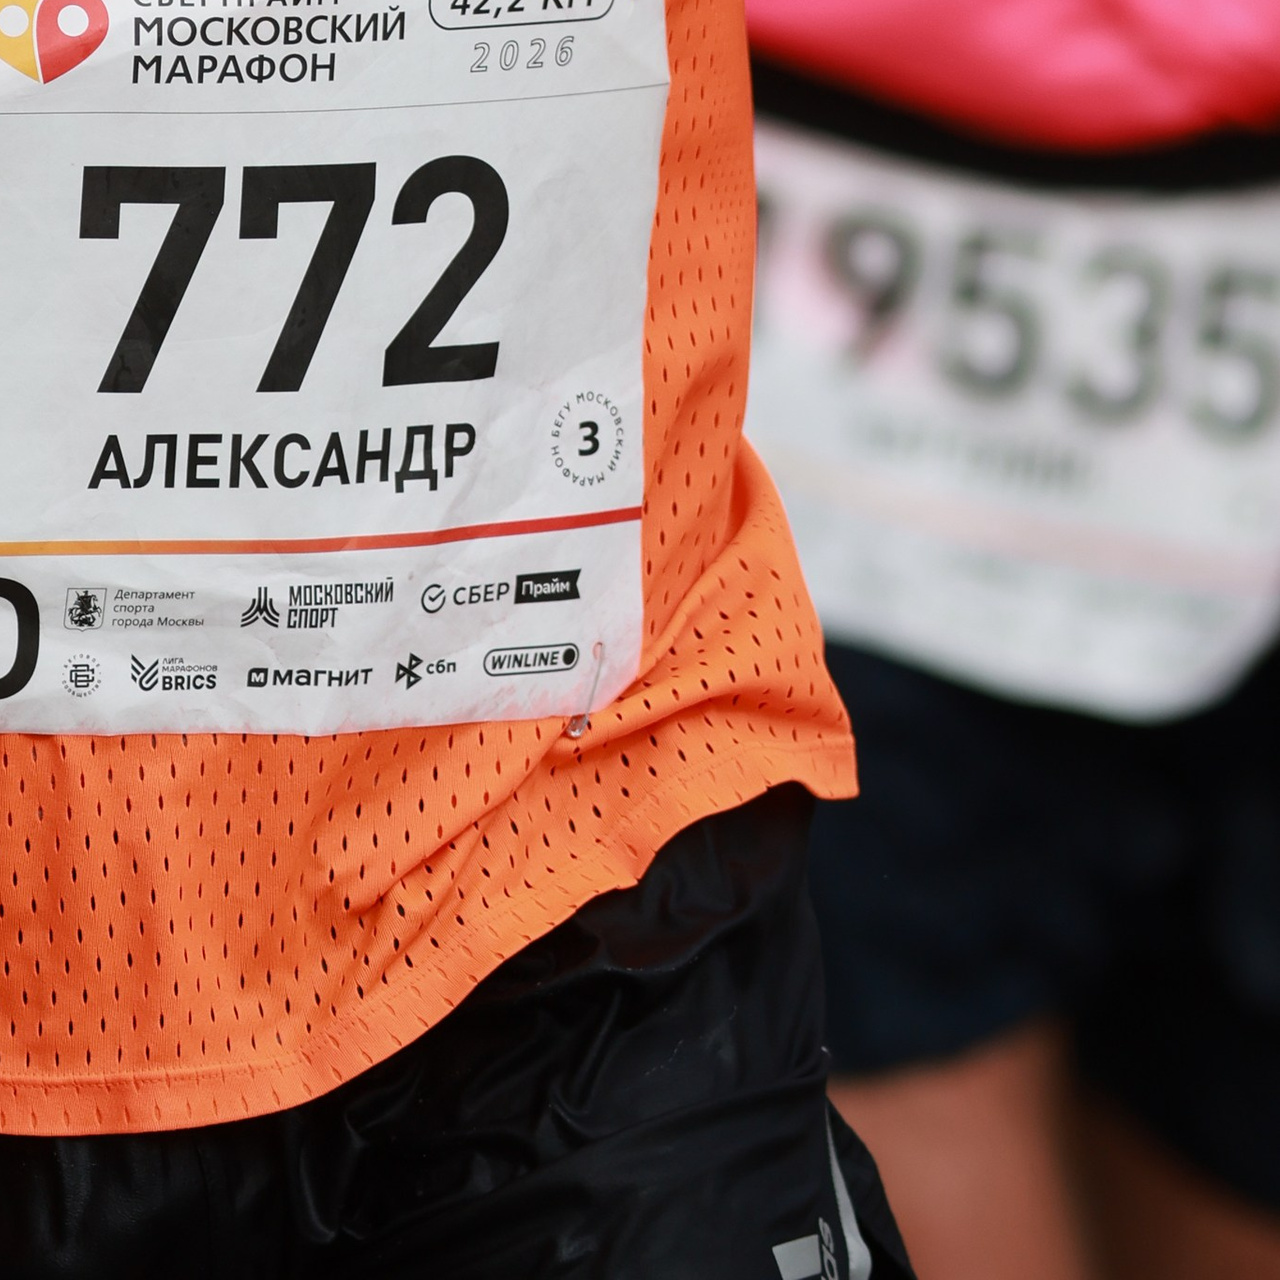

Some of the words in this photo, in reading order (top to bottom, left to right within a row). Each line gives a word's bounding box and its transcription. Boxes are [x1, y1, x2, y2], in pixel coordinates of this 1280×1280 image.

[132, 4, 407, 47] МОСКОВСКИЙ
[469, 35, 575, 74] 2026
[132, 52, 336, 84] МАРАФОН
[79, 155, 510, 394] 772
[755, 178, 1280, 450] 9535
[551, 402, 571, 438] БЕГУ
[576, 391, 624, 472] МОСКОВСКИЙ
[578, 421, 600, 457] 3
[87, 422, 476, 494] АЛЕКСАНДР
[551, 445, 605, 486] МАРАФОН
[114, 589, 195, 601] Департамент
[288, 576, 394, 607] МОСКОВСКИЙ
[453, 582, 510, 605] СБЕР
[521, 578, 570, 597] Прайм
[113, 604, 155, 614] спорта
[287, 607, 338, 628] СПОРТ
[112, 618, 154, 629] города
[157, 617, 204, 627] Москвы
[161, 657, 184, 666] ЛИГА
[161, 664, 218, 673] МАРАФОНОВ
[426, 659, 456, 674] сбп
[491, 651, 560, 670] WINLINE
[162, 674, 217, 690] BRICS
[272, 668, 373, 687] магнит
